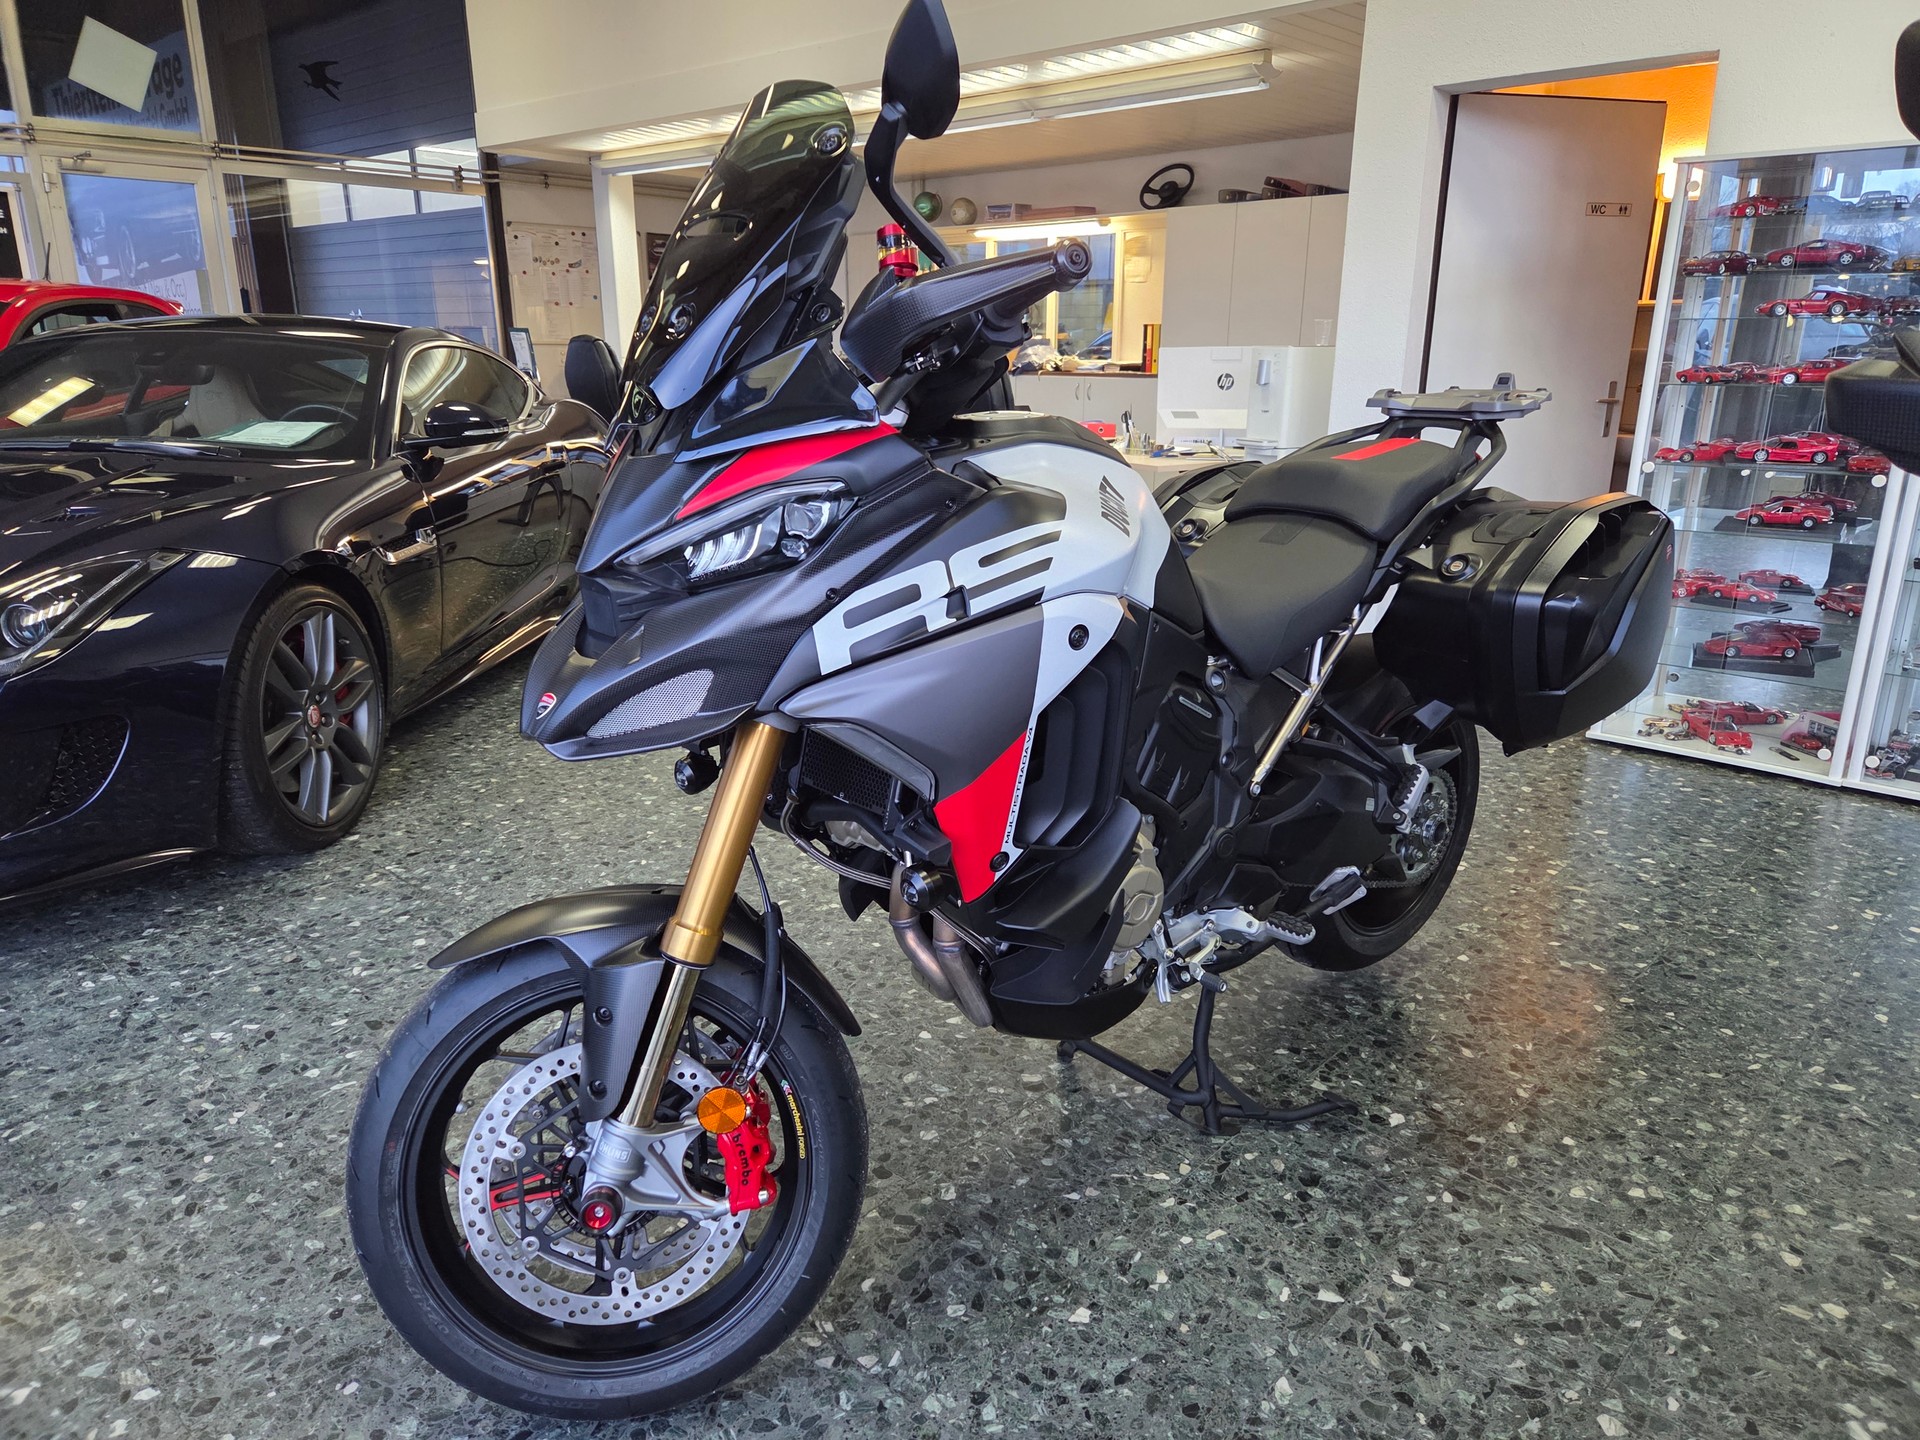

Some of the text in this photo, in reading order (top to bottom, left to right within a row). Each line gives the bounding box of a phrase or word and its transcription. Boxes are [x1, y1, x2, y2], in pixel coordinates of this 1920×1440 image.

[1591, 204, 1607, 215] WC
[1217, 373, 1234, 391] hp
[812, 519, 1065, 676] RS
[1005, 727, 1033, 844] MULTISTRADA V4
[786, 1094, 805, 1137] marchesini
[732, 1133, 752, 1186] brembo
